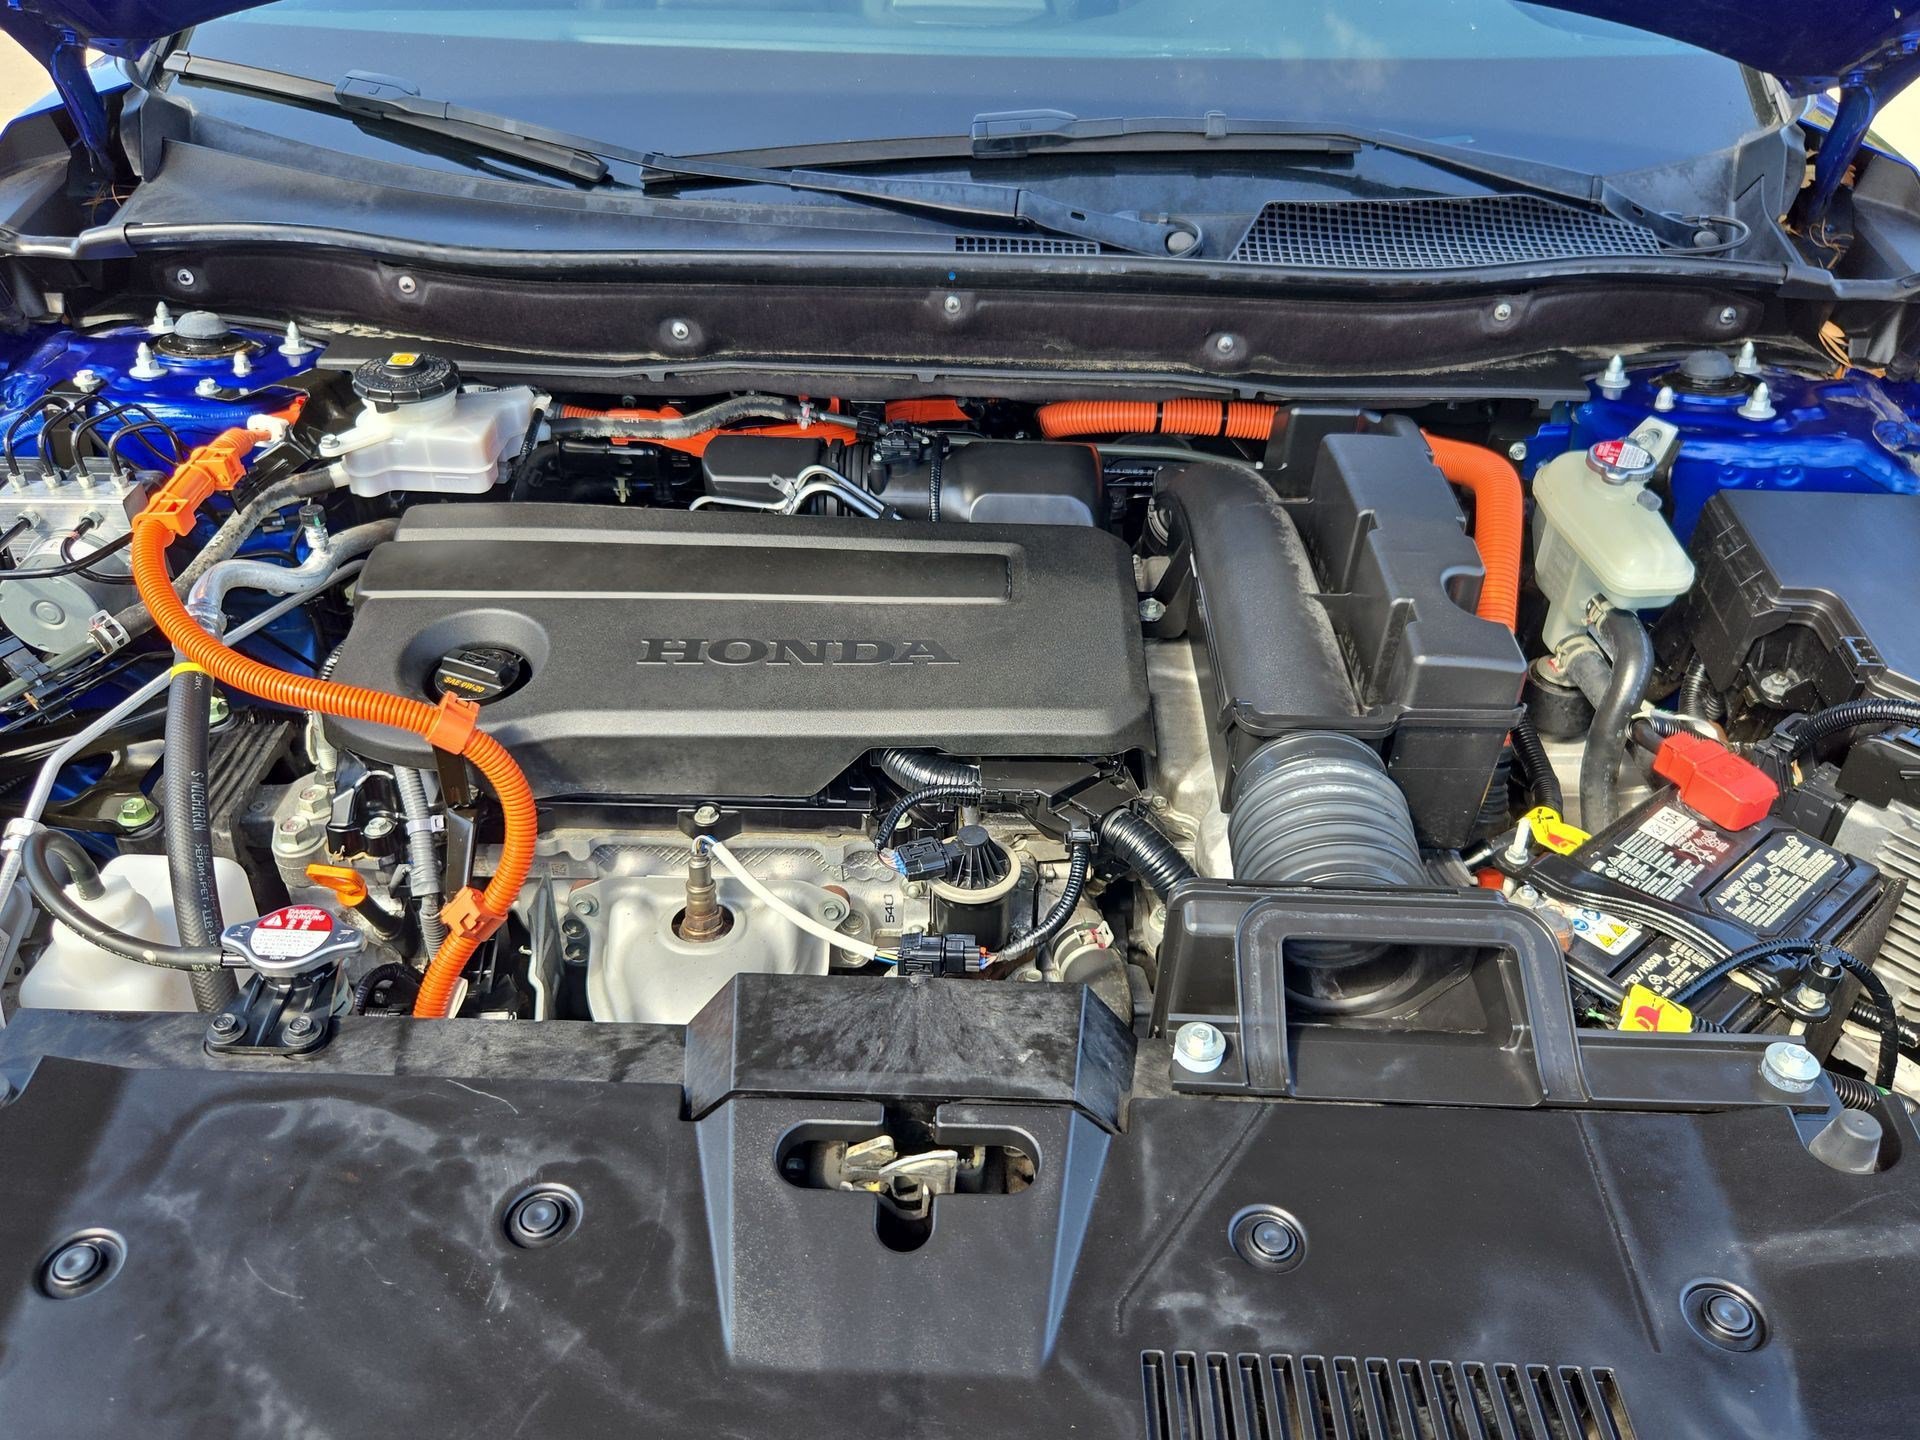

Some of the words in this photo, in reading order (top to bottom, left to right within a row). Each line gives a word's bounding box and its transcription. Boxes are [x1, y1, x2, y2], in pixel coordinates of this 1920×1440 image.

[636, 638, 960, 666] HONDA
[444, 676, 462, 686] SAE
[461, 681, 485, 693] 0W-20
[885, 894, 895, 923] 540
